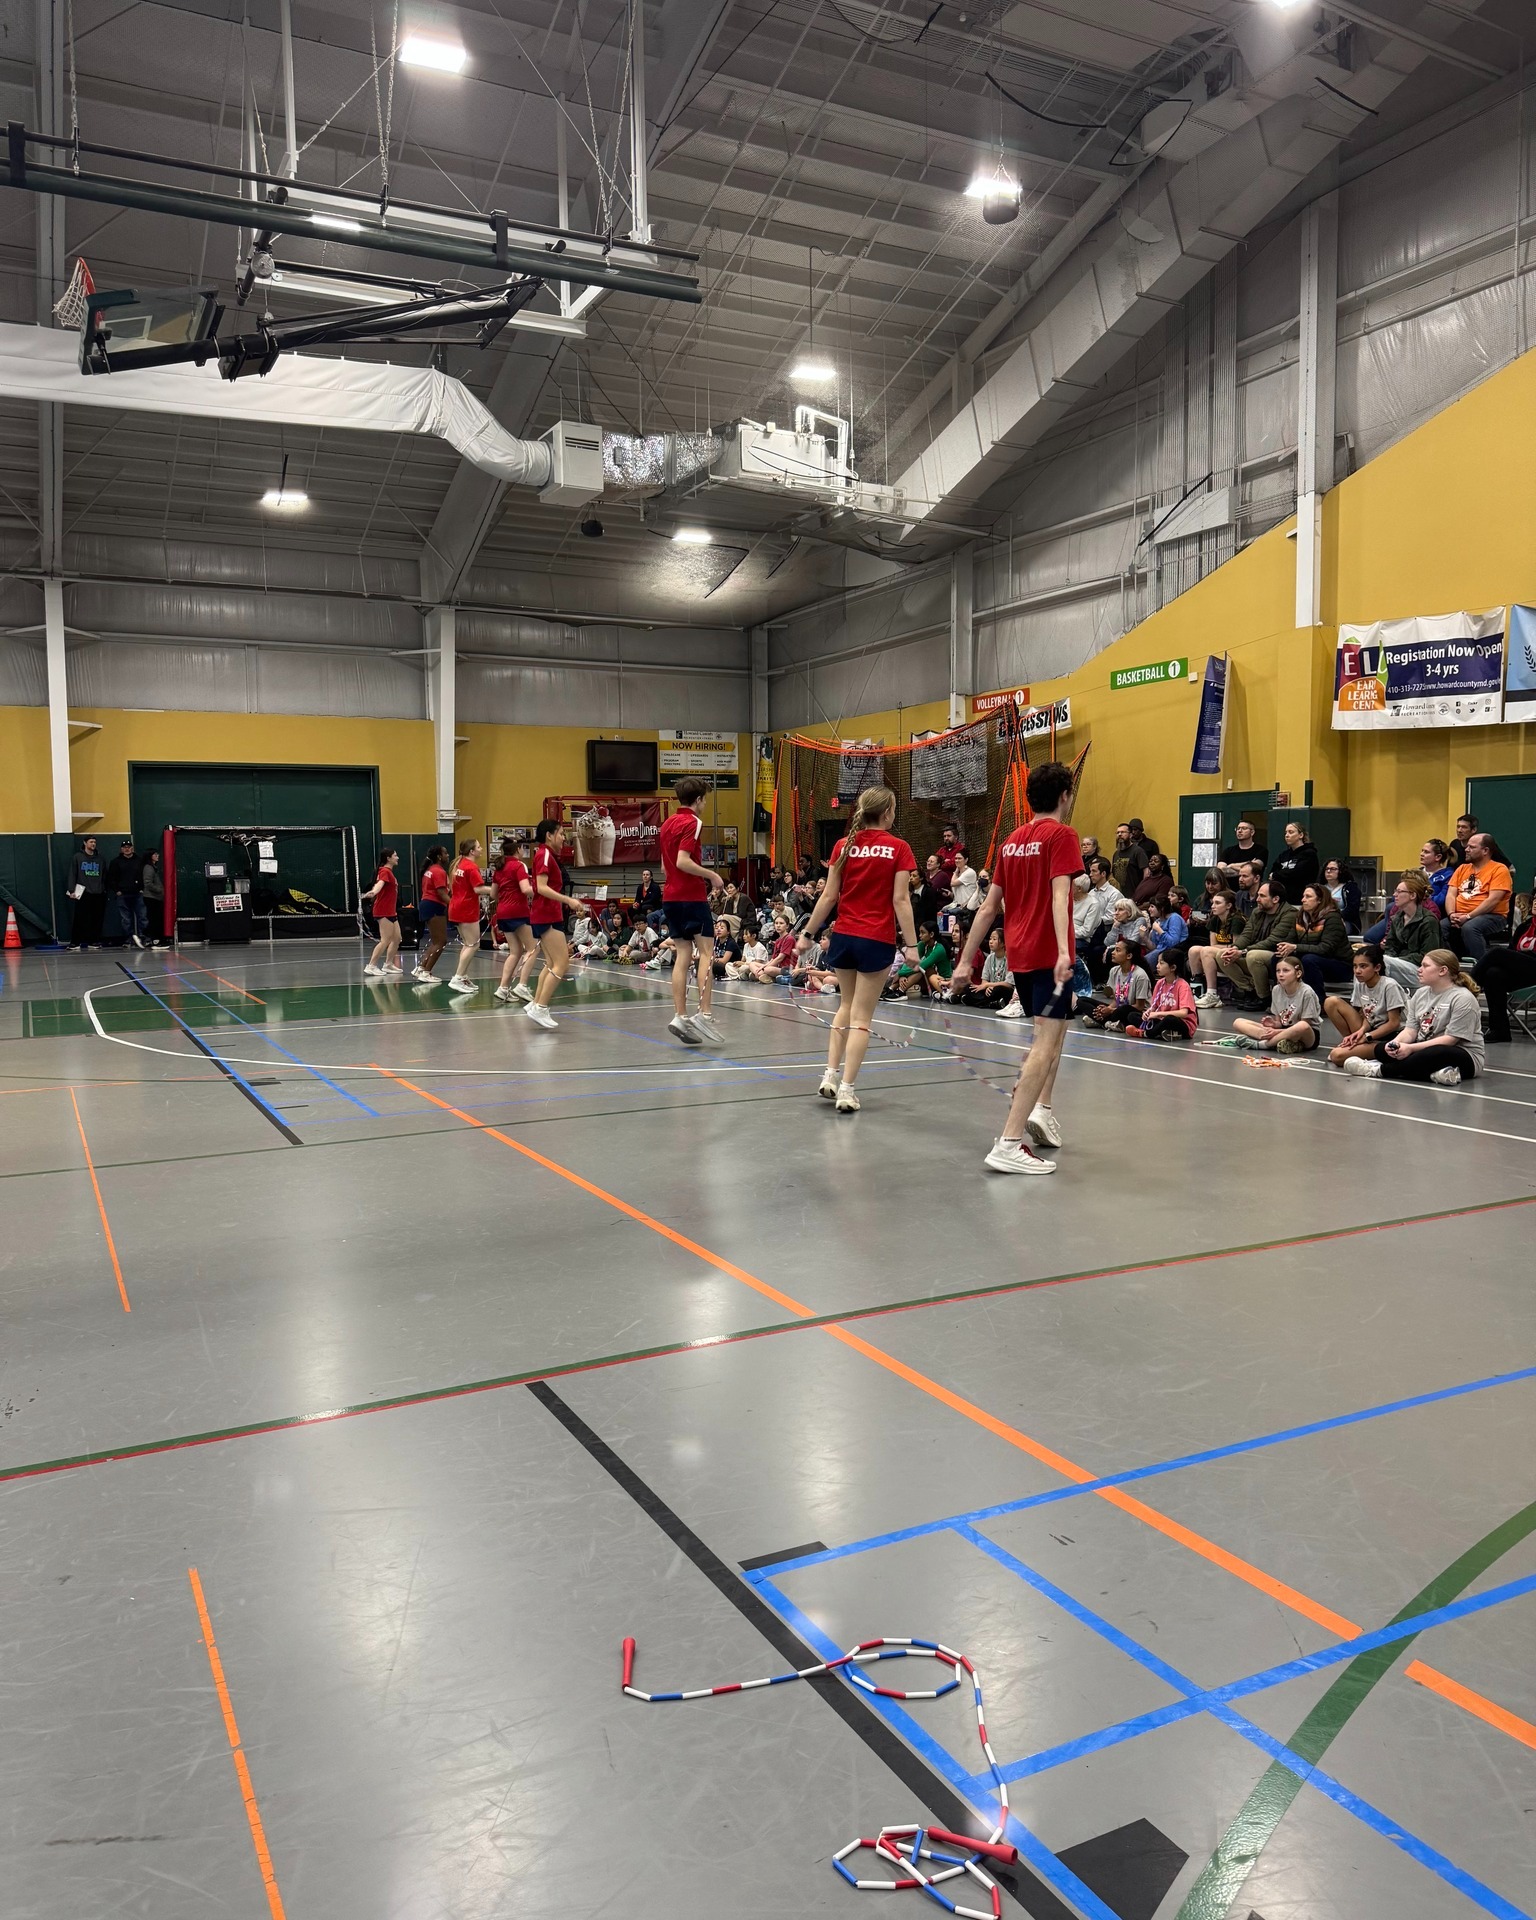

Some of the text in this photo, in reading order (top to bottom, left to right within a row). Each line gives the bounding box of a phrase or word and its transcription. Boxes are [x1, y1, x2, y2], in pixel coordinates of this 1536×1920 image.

[1447, 643, 1475, 657] Now
[1116, 665, 1165, 686] BASKETBALL
[1426, 663, 1459, 678] 3-4 yrs
[672, 742, 726, 751] NOW HIRING!
